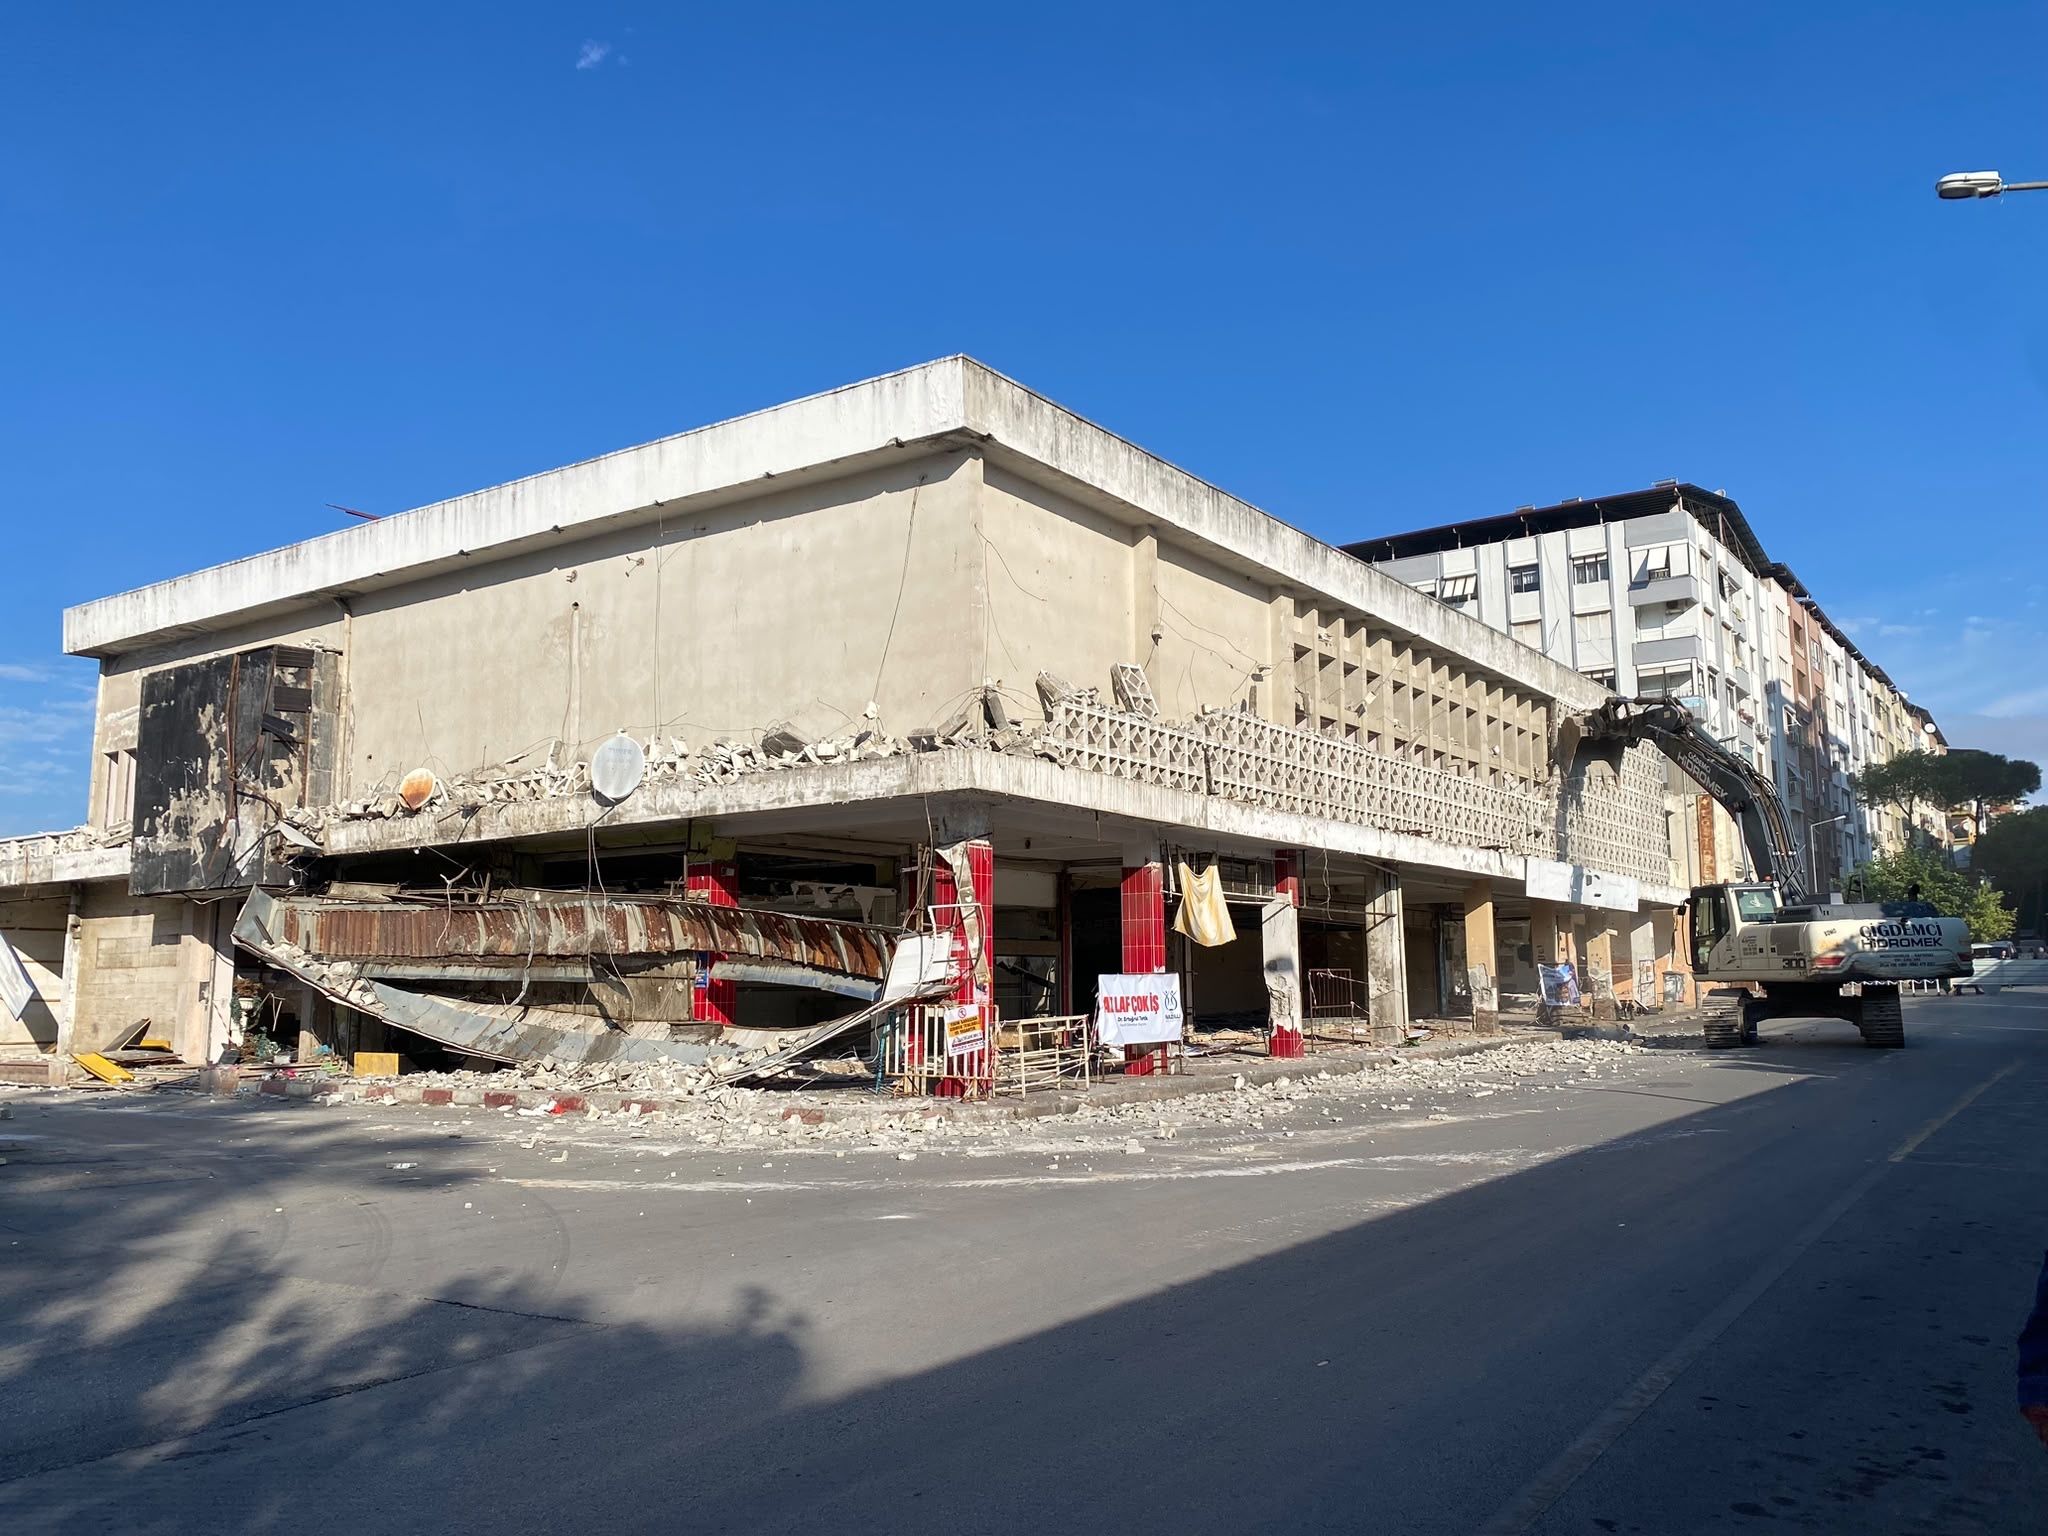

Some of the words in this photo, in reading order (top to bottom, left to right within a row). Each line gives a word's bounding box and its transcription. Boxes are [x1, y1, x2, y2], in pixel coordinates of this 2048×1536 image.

[1861, 937, 1943, 949] HİDROMEK
[1782, 958, 1807, 969] 300
[1115, 996, 1130, 1013] LAF
[1131, 994, 1149, 1015] ÇOK
[1150, 992, 1159, 1014] İŞ
